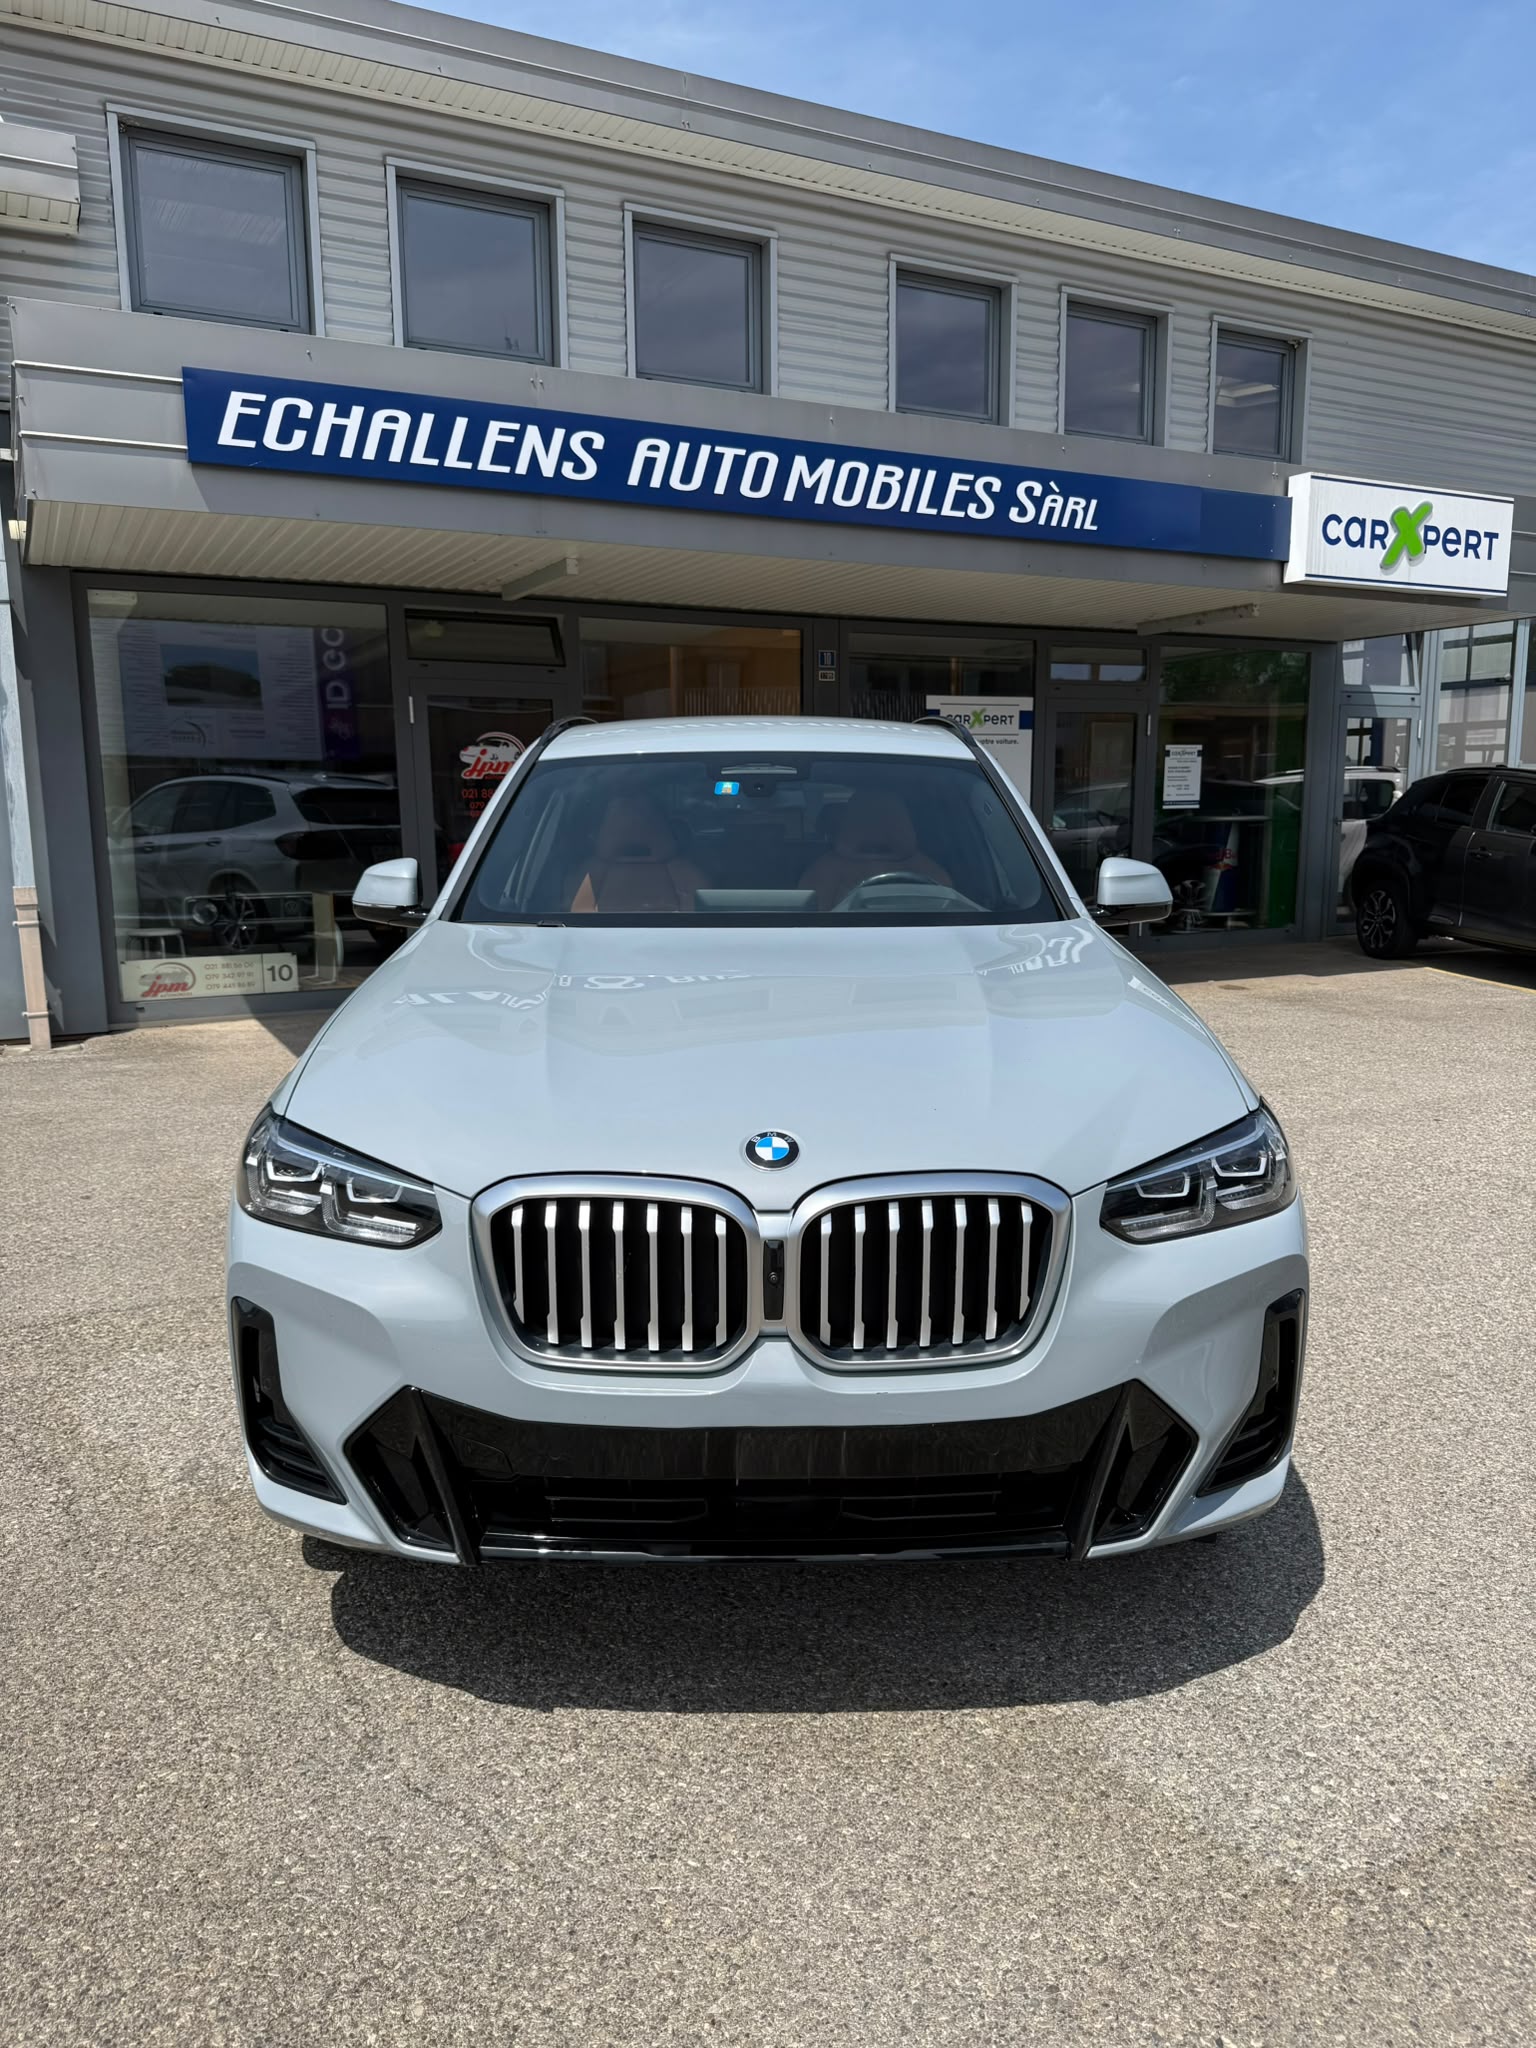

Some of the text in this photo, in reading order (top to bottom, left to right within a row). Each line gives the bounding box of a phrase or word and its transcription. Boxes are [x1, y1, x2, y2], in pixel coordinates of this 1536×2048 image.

[217, 390, 606, 481] ECHALLENS
[267, 964, 293, 982] 10
[141, 975, 189, 998] jpm
[750, 1132, 795, 1143] BMW
